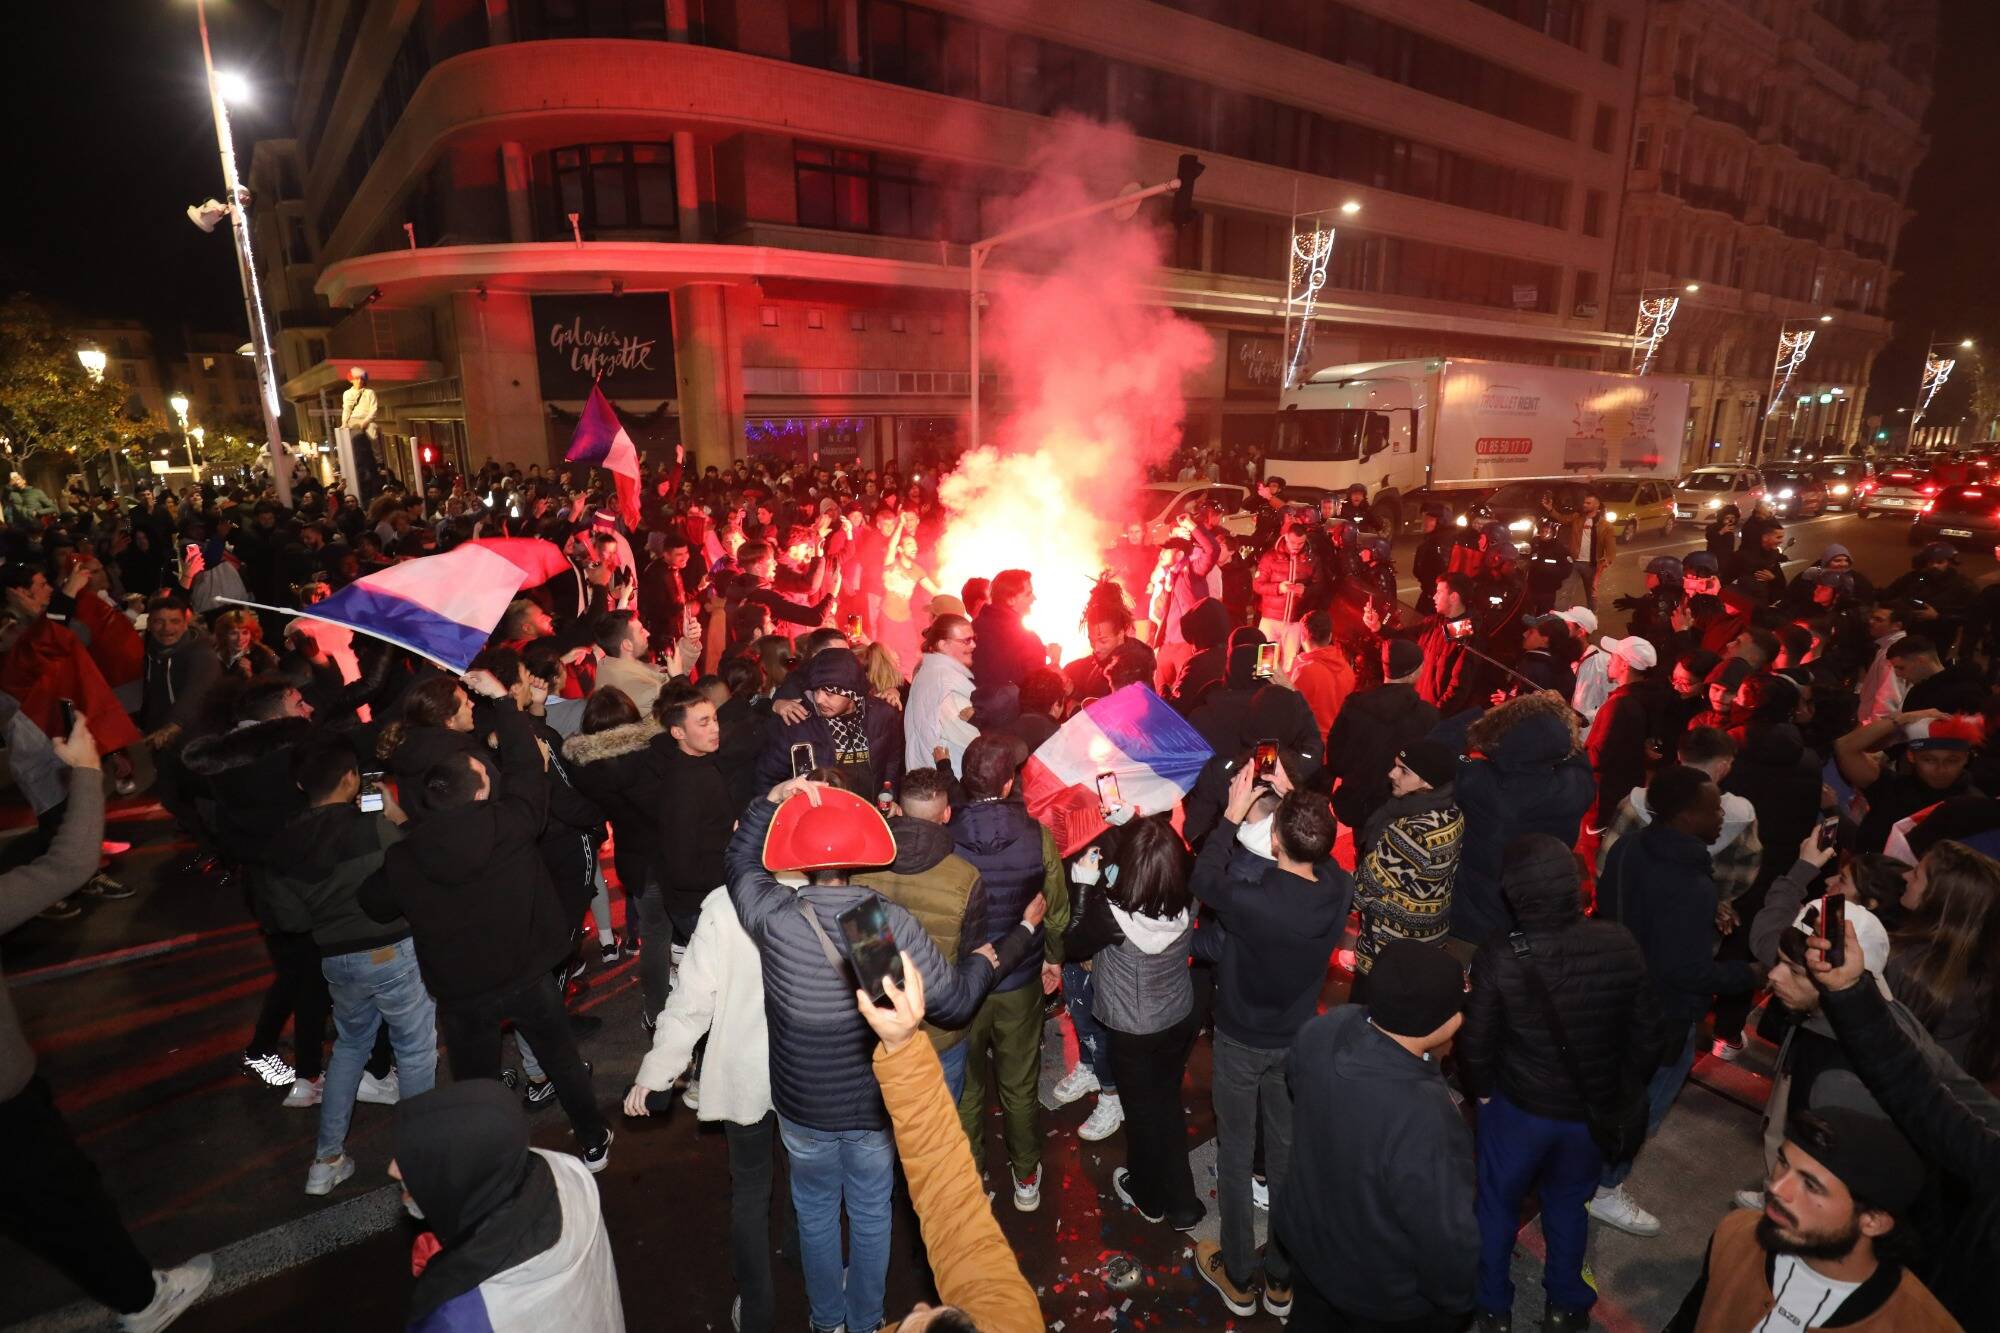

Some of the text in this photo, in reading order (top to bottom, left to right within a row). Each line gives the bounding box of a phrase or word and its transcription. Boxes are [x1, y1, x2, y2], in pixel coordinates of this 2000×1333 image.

[550, 316, 621, 355] Galeries
[570, 336, 657, 378] Lafayette
[1478, 440, 1487, 454] 01
[1489, 440, 1499, 454] 85
[1777, 1306, 1801, 1327] BZB
